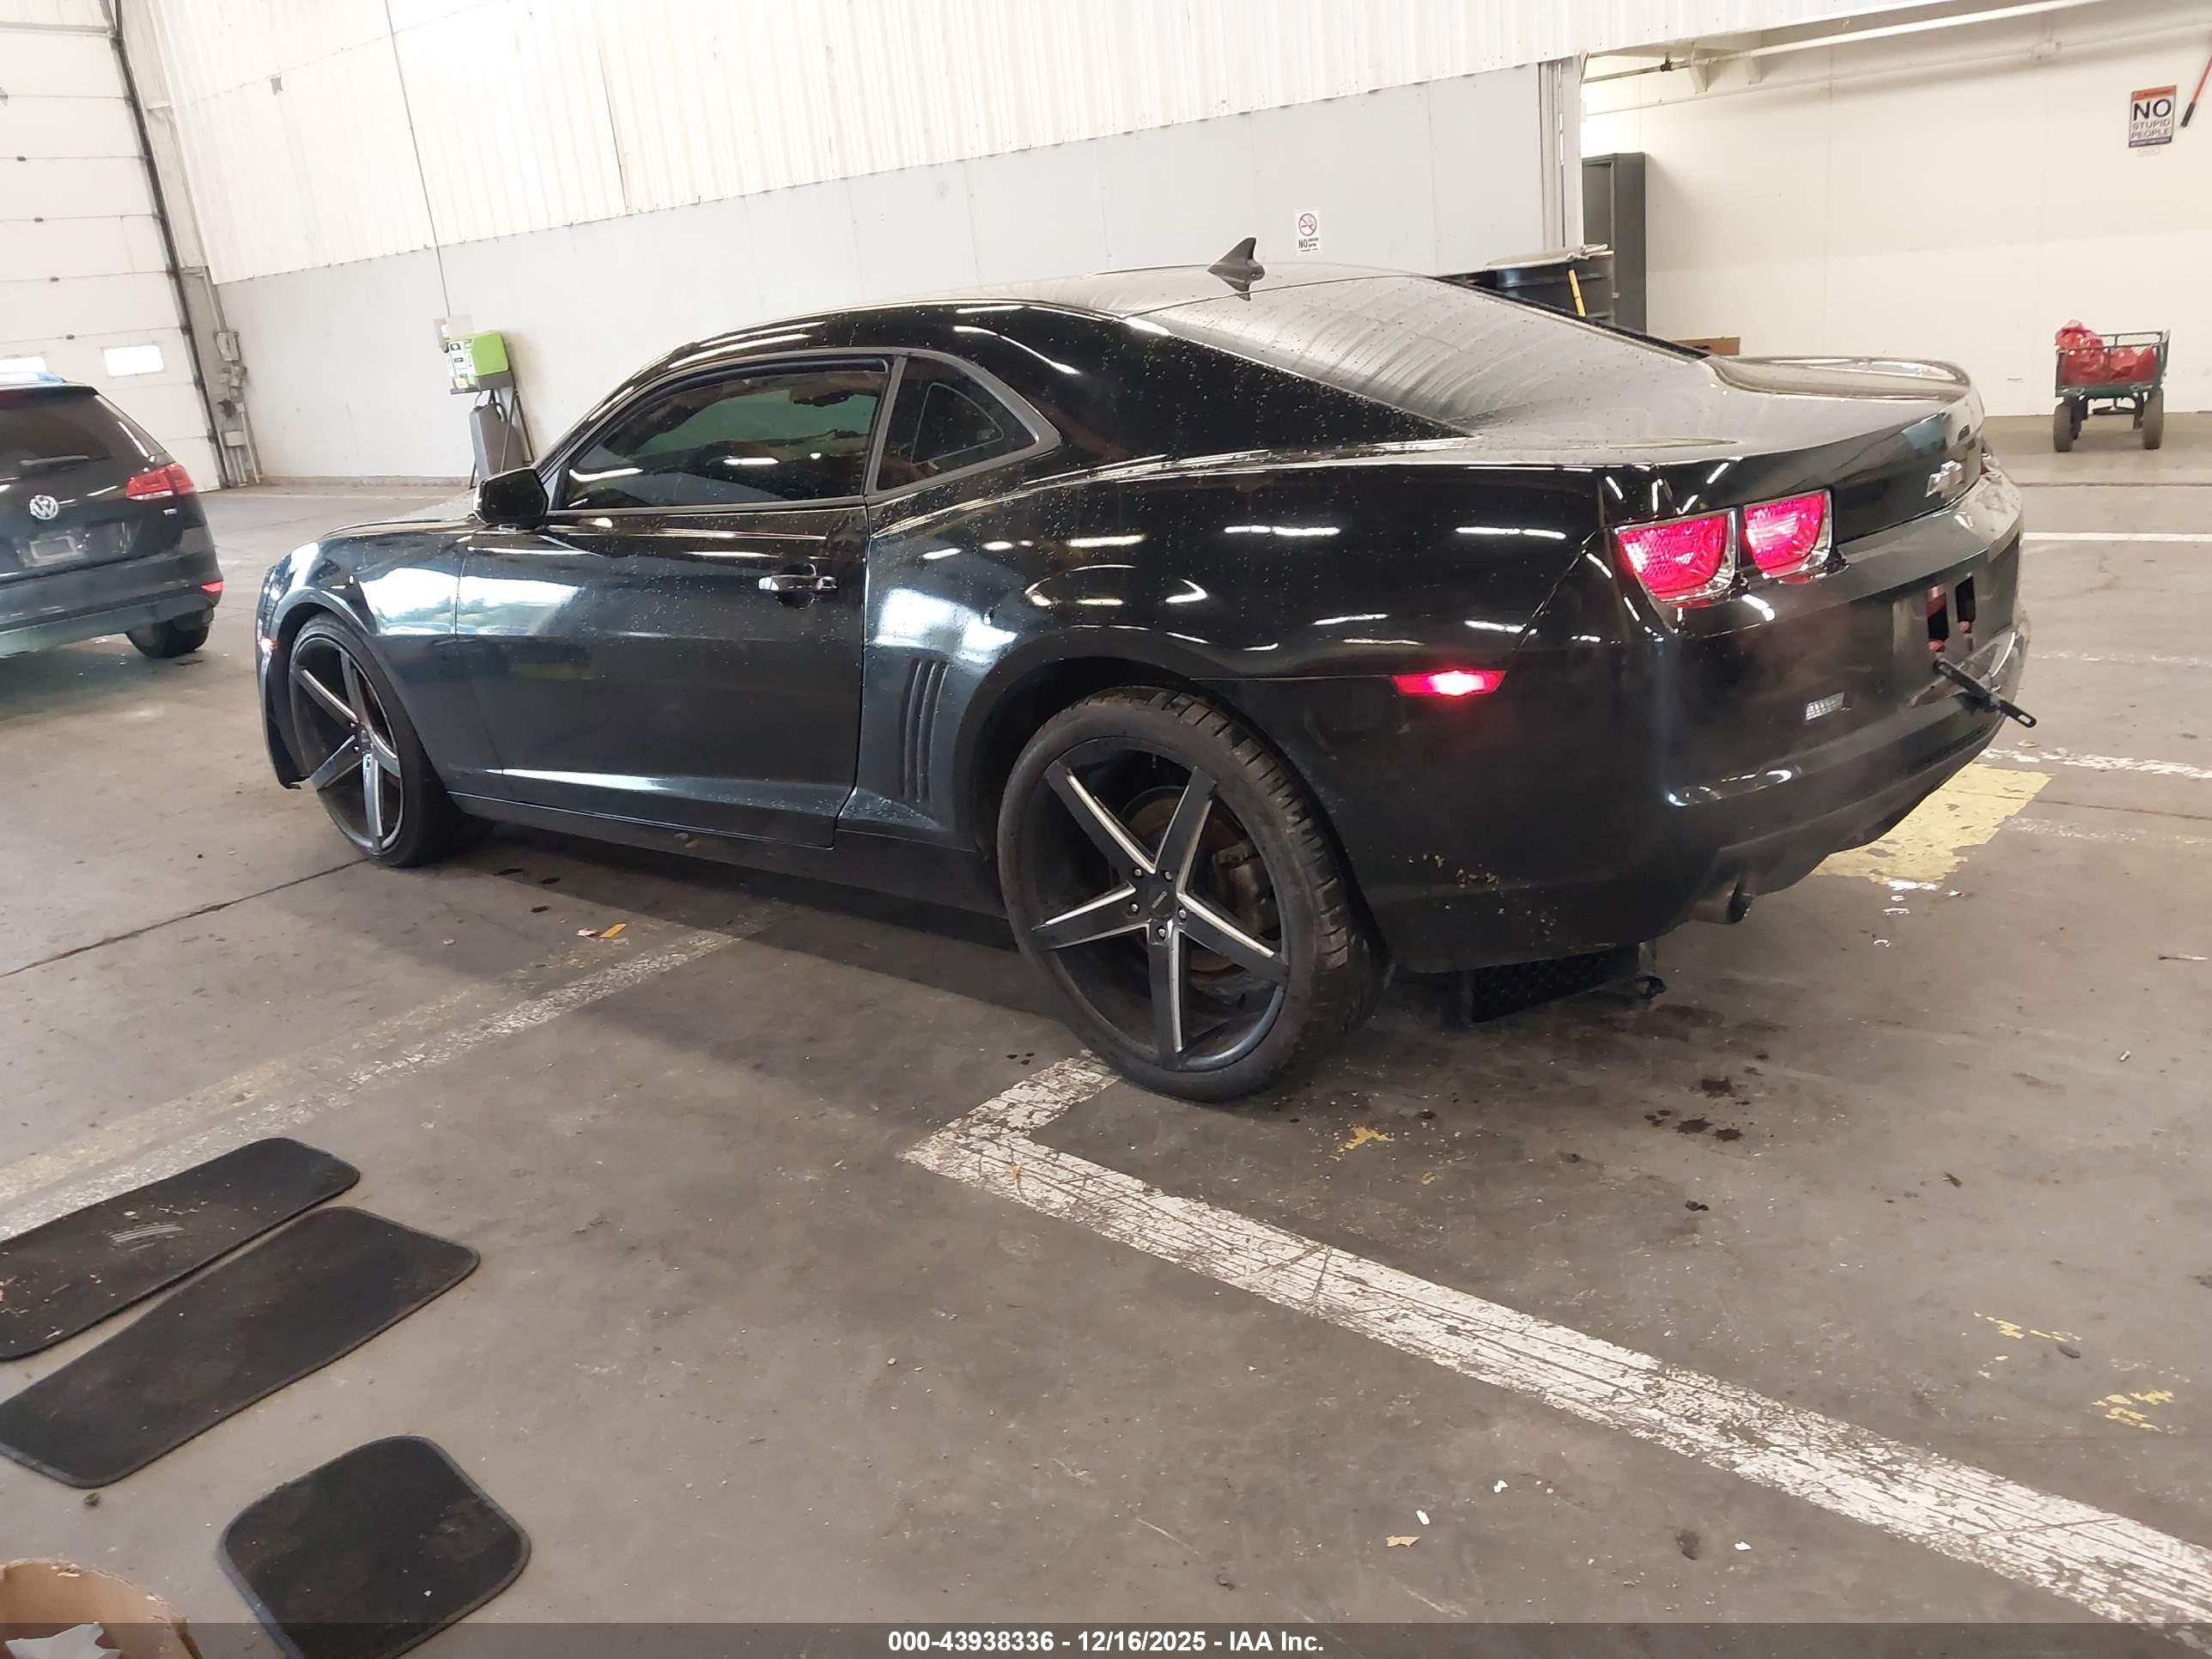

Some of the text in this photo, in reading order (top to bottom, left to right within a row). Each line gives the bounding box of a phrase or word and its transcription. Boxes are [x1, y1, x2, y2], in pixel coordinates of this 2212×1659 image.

[2133, 99, 2172, 121] NO
[2132, 119, 2171, 131] STUPID
[2130, 128, 2169, 138] PEOPLE
[1298, 239, 1308, 248] NO
